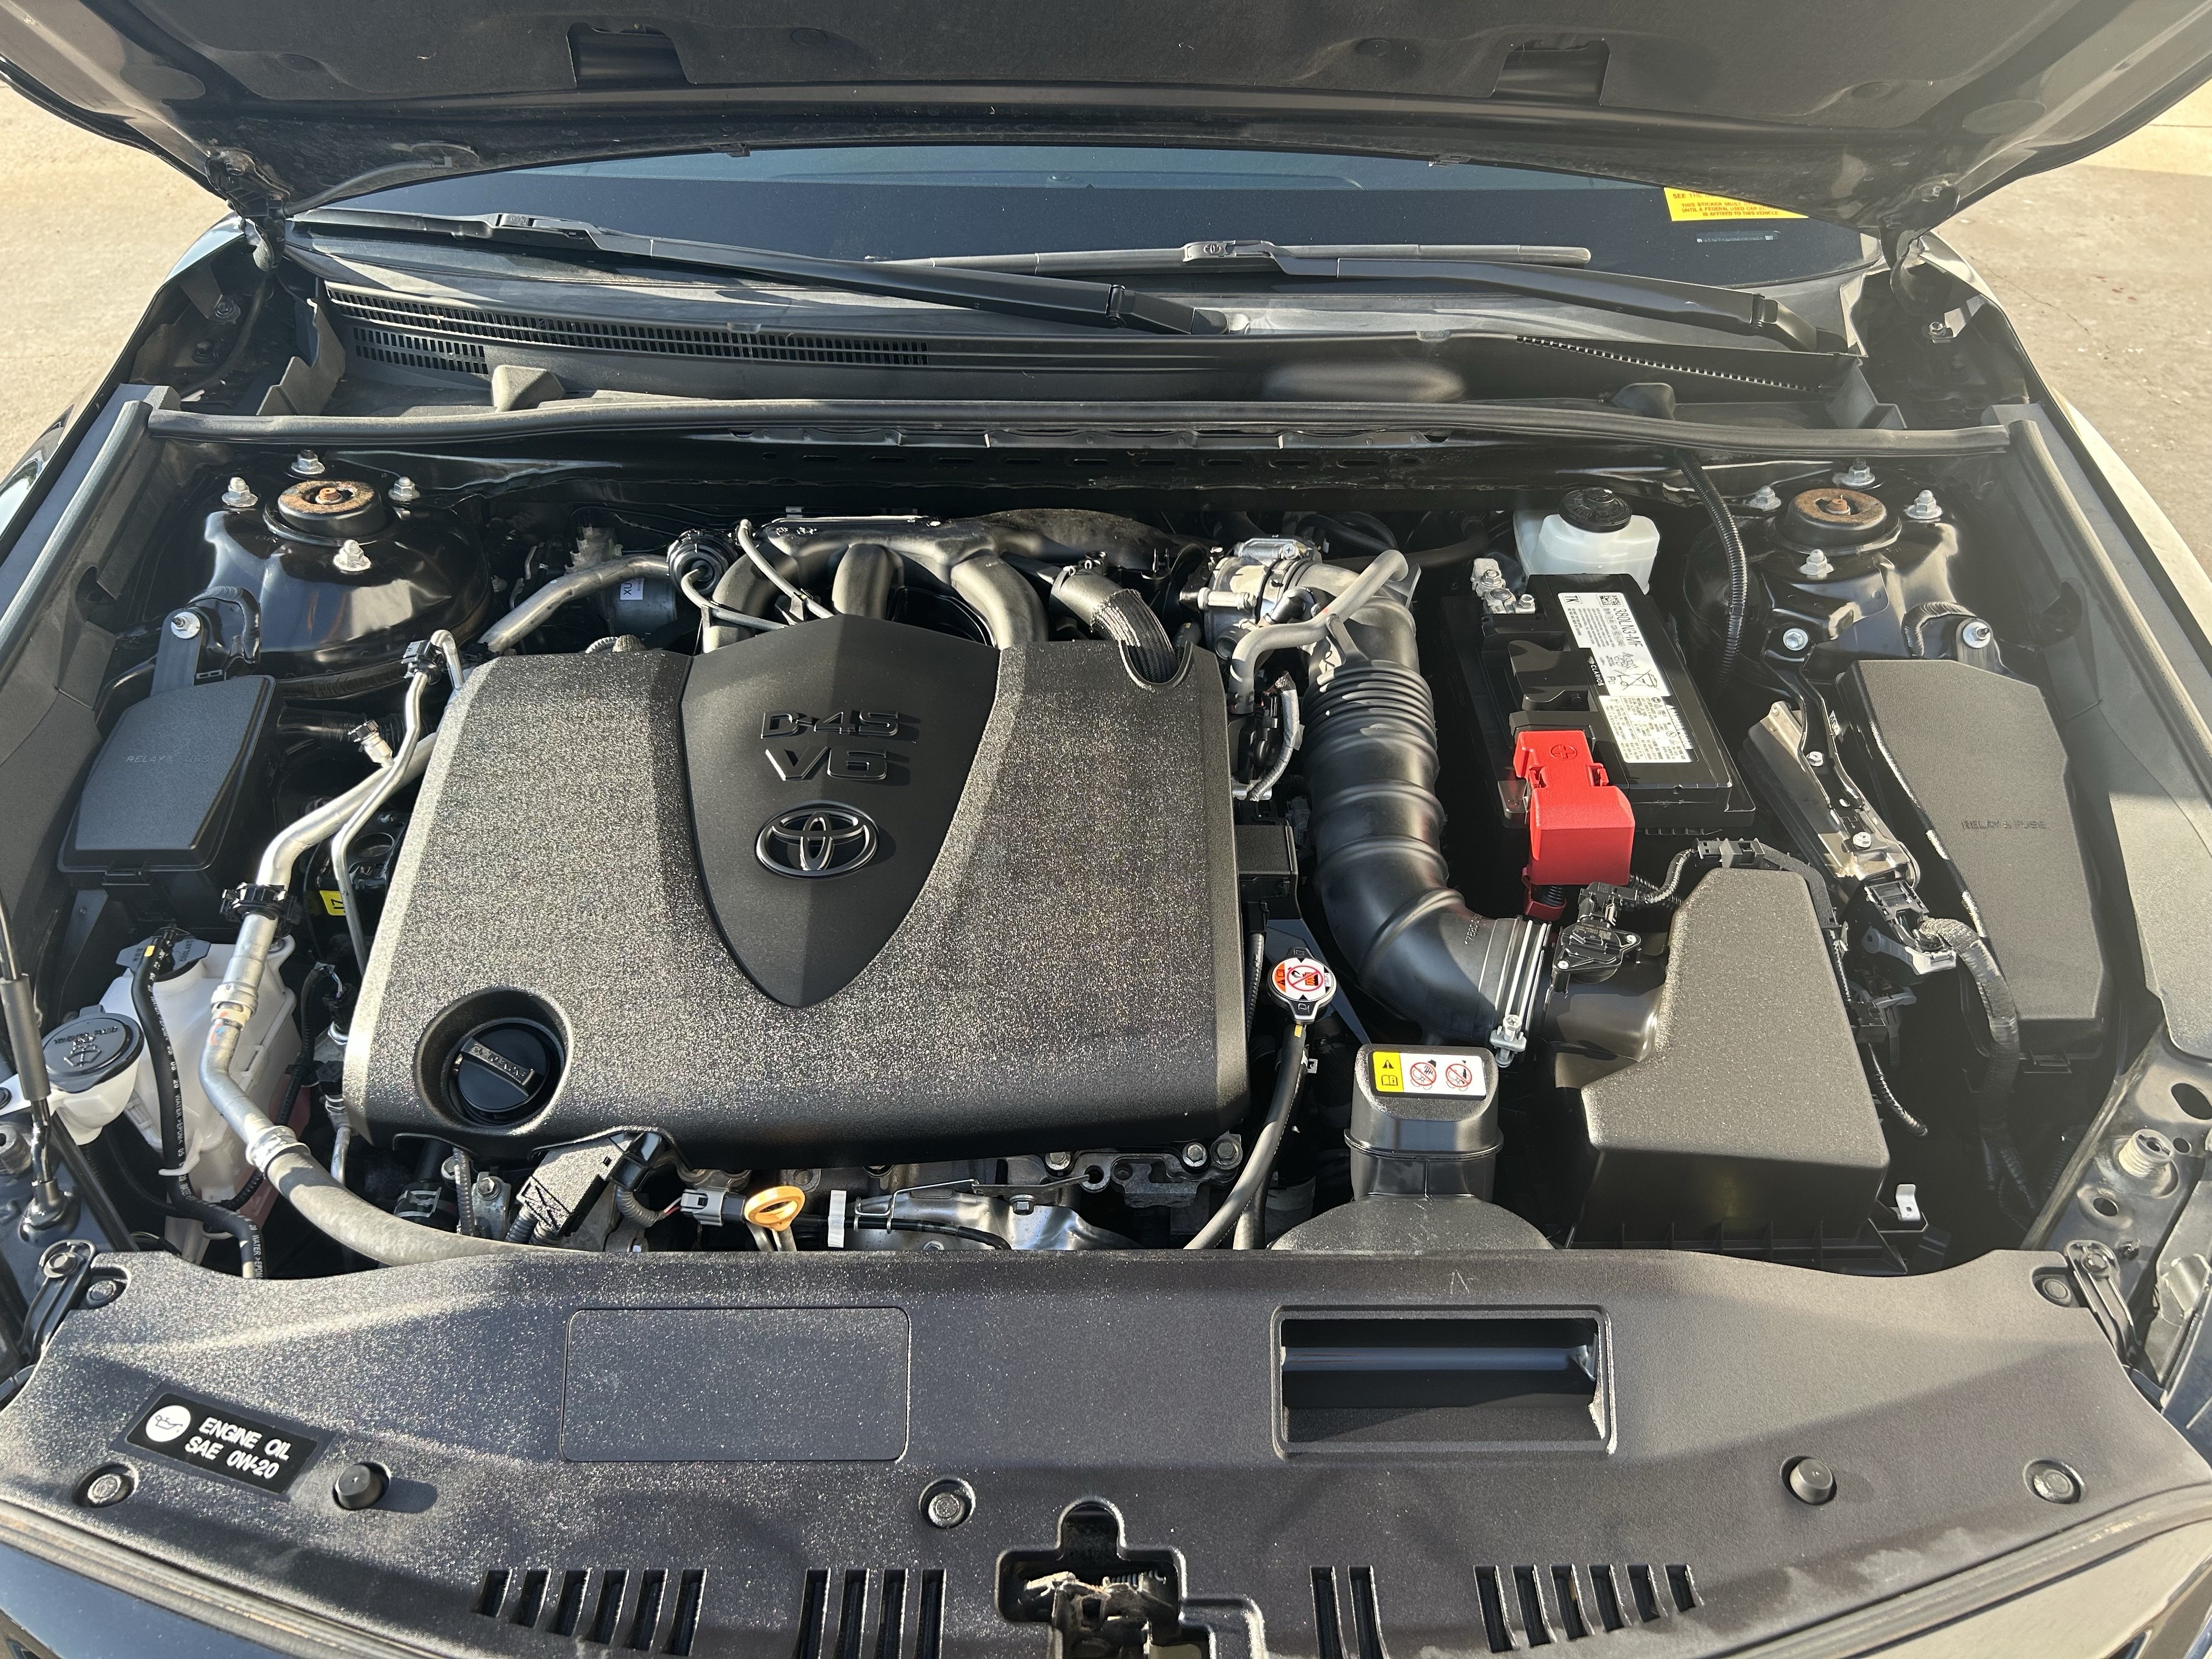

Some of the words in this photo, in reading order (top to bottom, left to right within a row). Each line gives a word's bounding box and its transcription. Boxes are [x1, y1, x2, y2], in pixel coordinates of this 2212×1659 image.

[623, 583, 632, 595] XU
[1613, 608, 1643, 647] 380LN3-MF
[1591, 664, 1604, 686] CLARIOS
[761, 710, 899, 739] D-4S
[765, 746, 887, 781] V6
[1961, 820, 1999, 829] RELAY
[2014, 820, 2047, 829] FUSE
[173, 1079, 180, 1088] 20
[252, 1234, 262, 1256] WATER
[255, 1257, 264, 1279] >EPDM
[199, 1417, 262, 1449] ENGINE
[264, 1438, 292, 1461] OIL
[185, 1436, 224, 1460] SAE
[227, 1451, 280, 1479] 0W-20
